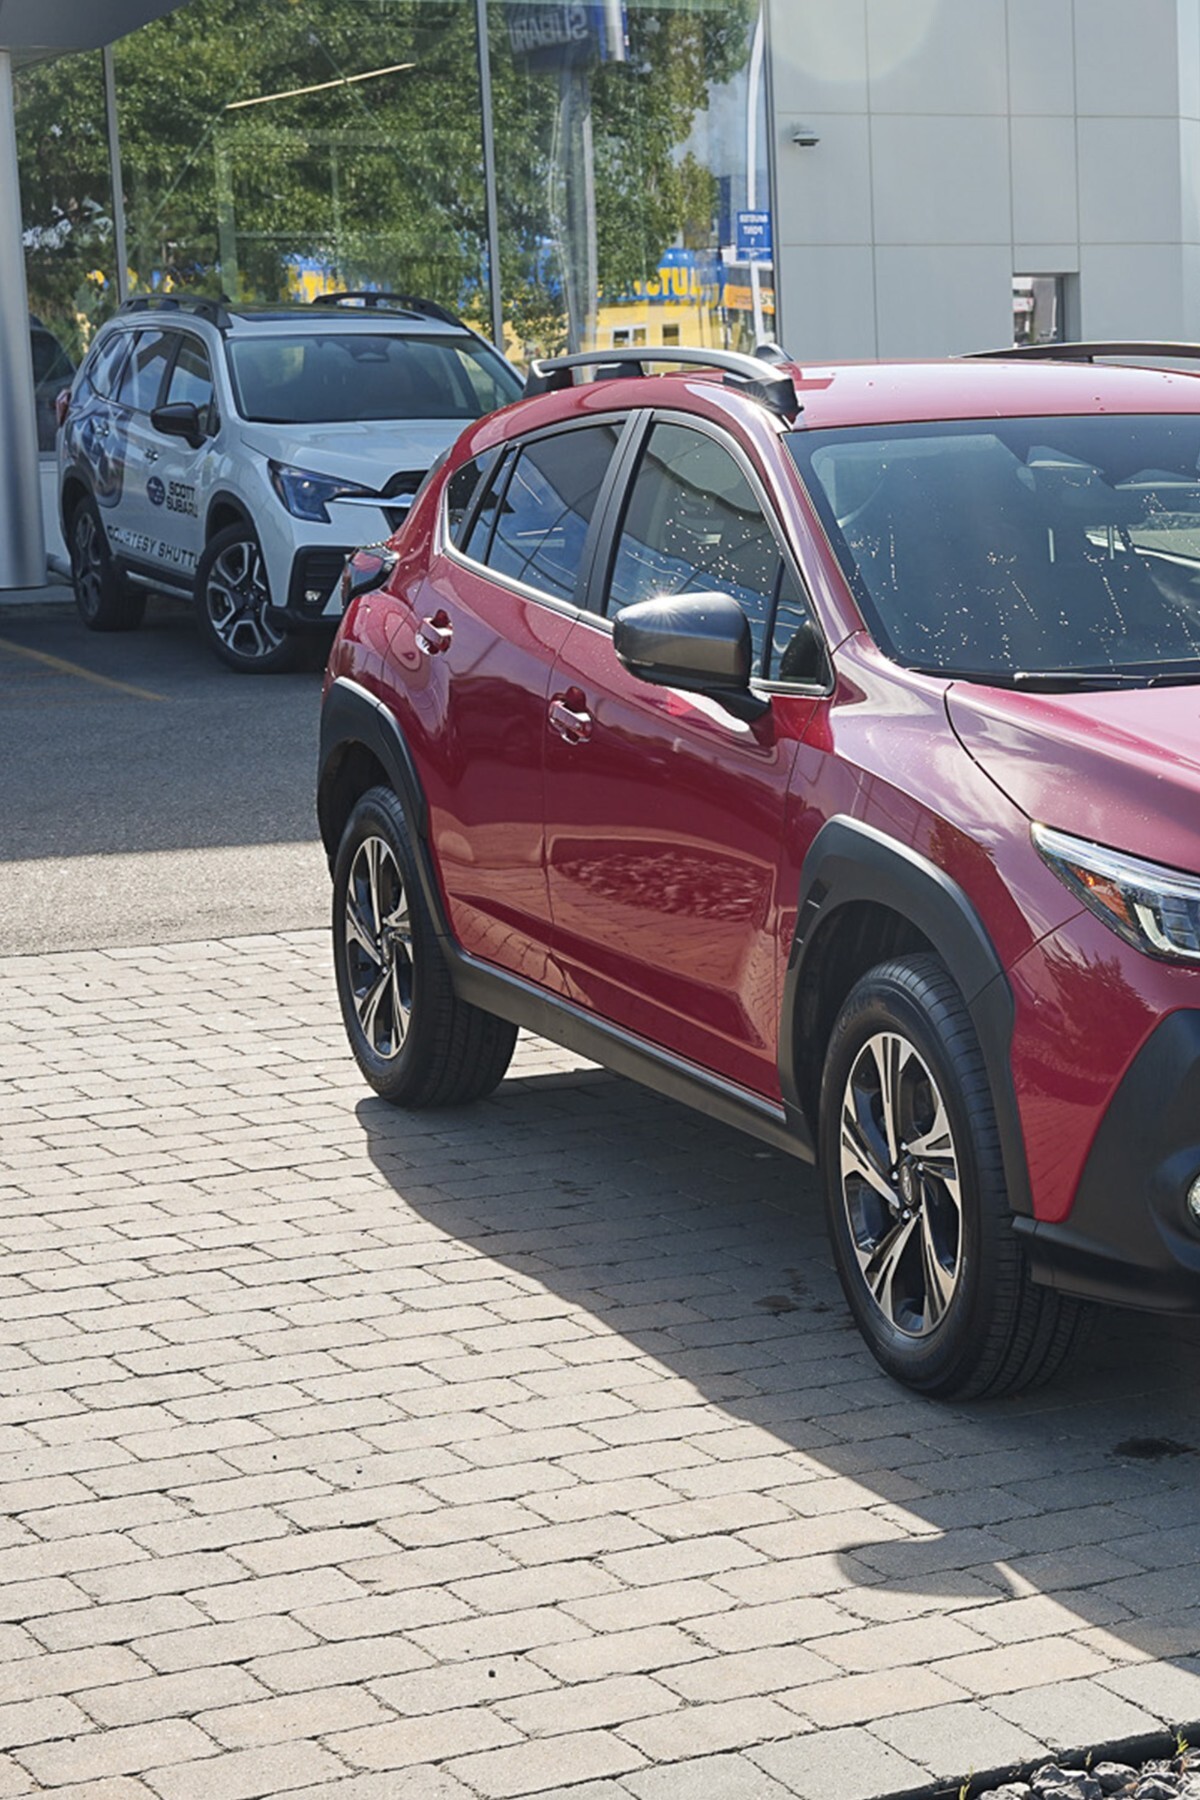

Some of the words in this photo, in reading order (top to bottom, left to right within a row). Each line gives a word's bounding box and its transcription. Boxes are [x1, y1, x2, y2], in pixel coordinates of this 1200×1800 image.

[168, 481, 196, 500] SCOTT
[166, 496, 199, 518] SUBARU
[158, 542, 200, 569] SHUTTL
